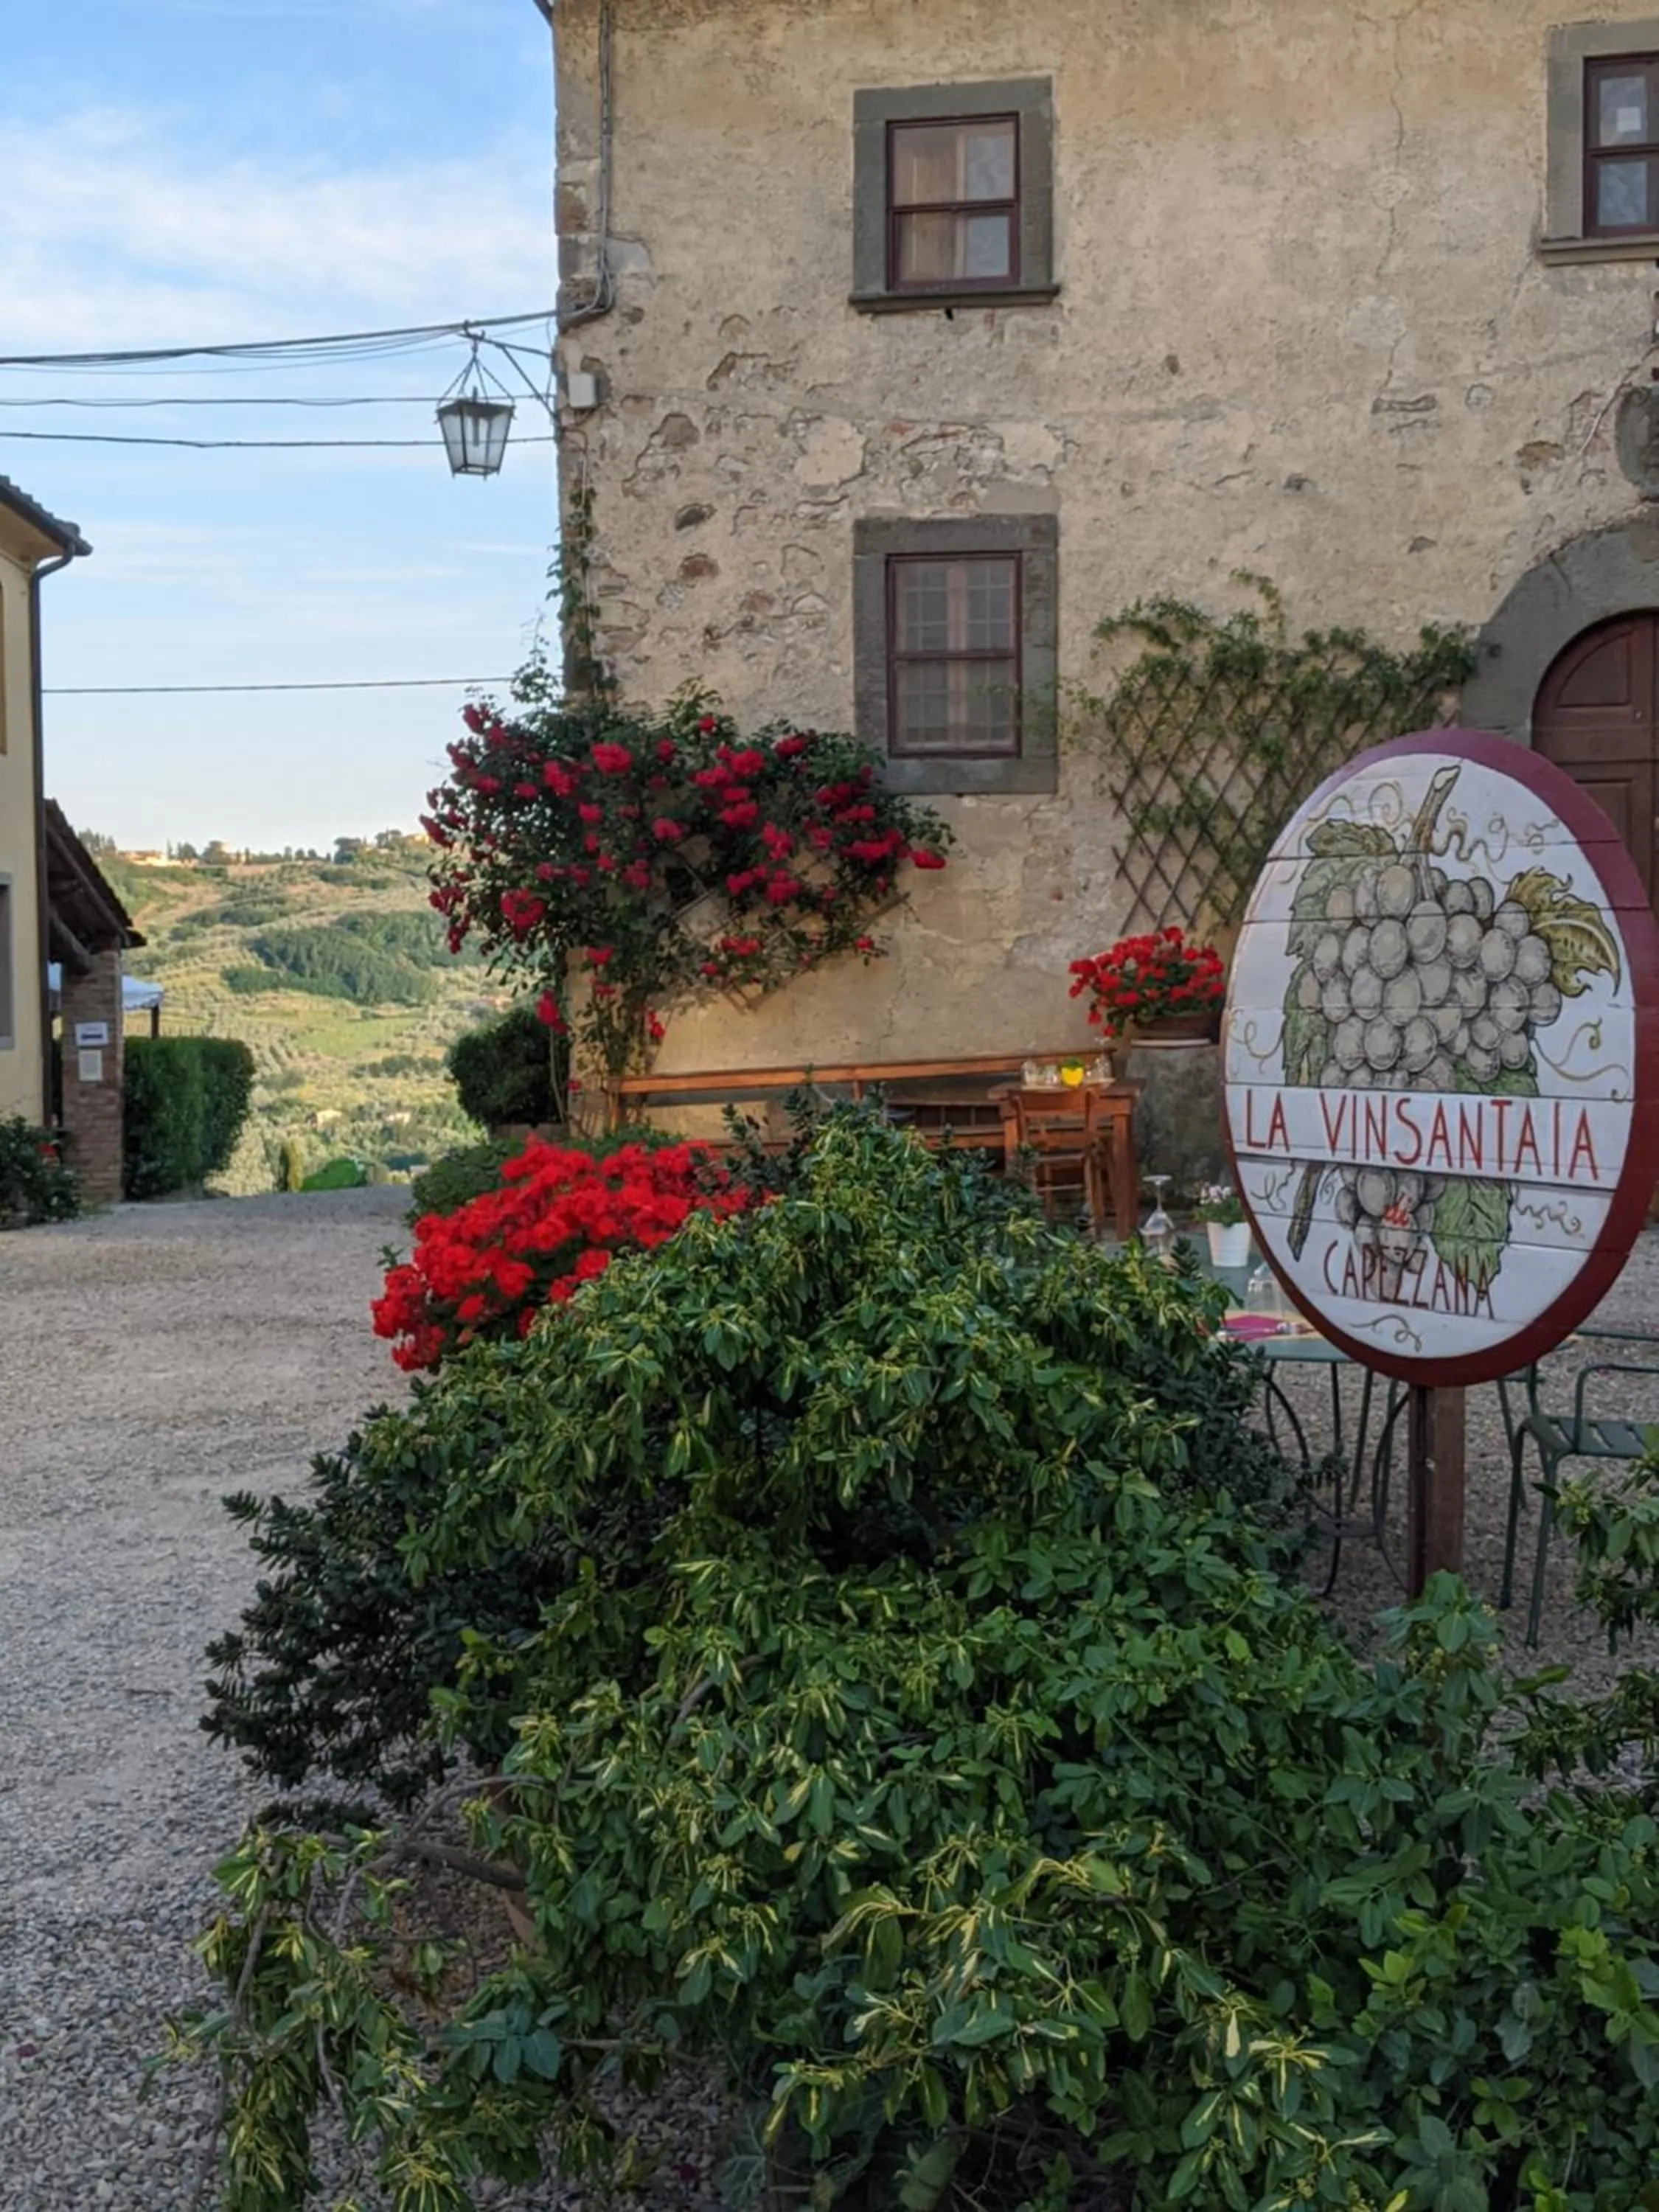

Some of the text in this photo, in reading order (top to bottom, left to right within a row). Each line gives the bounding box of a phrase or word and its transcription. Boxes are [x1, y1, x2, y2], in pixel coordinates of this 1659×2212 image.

[1245, 1089, 1599, 1180] LA VINSANTAIA
[1324, 1240, 1495, 1320] CAPEZZANA
